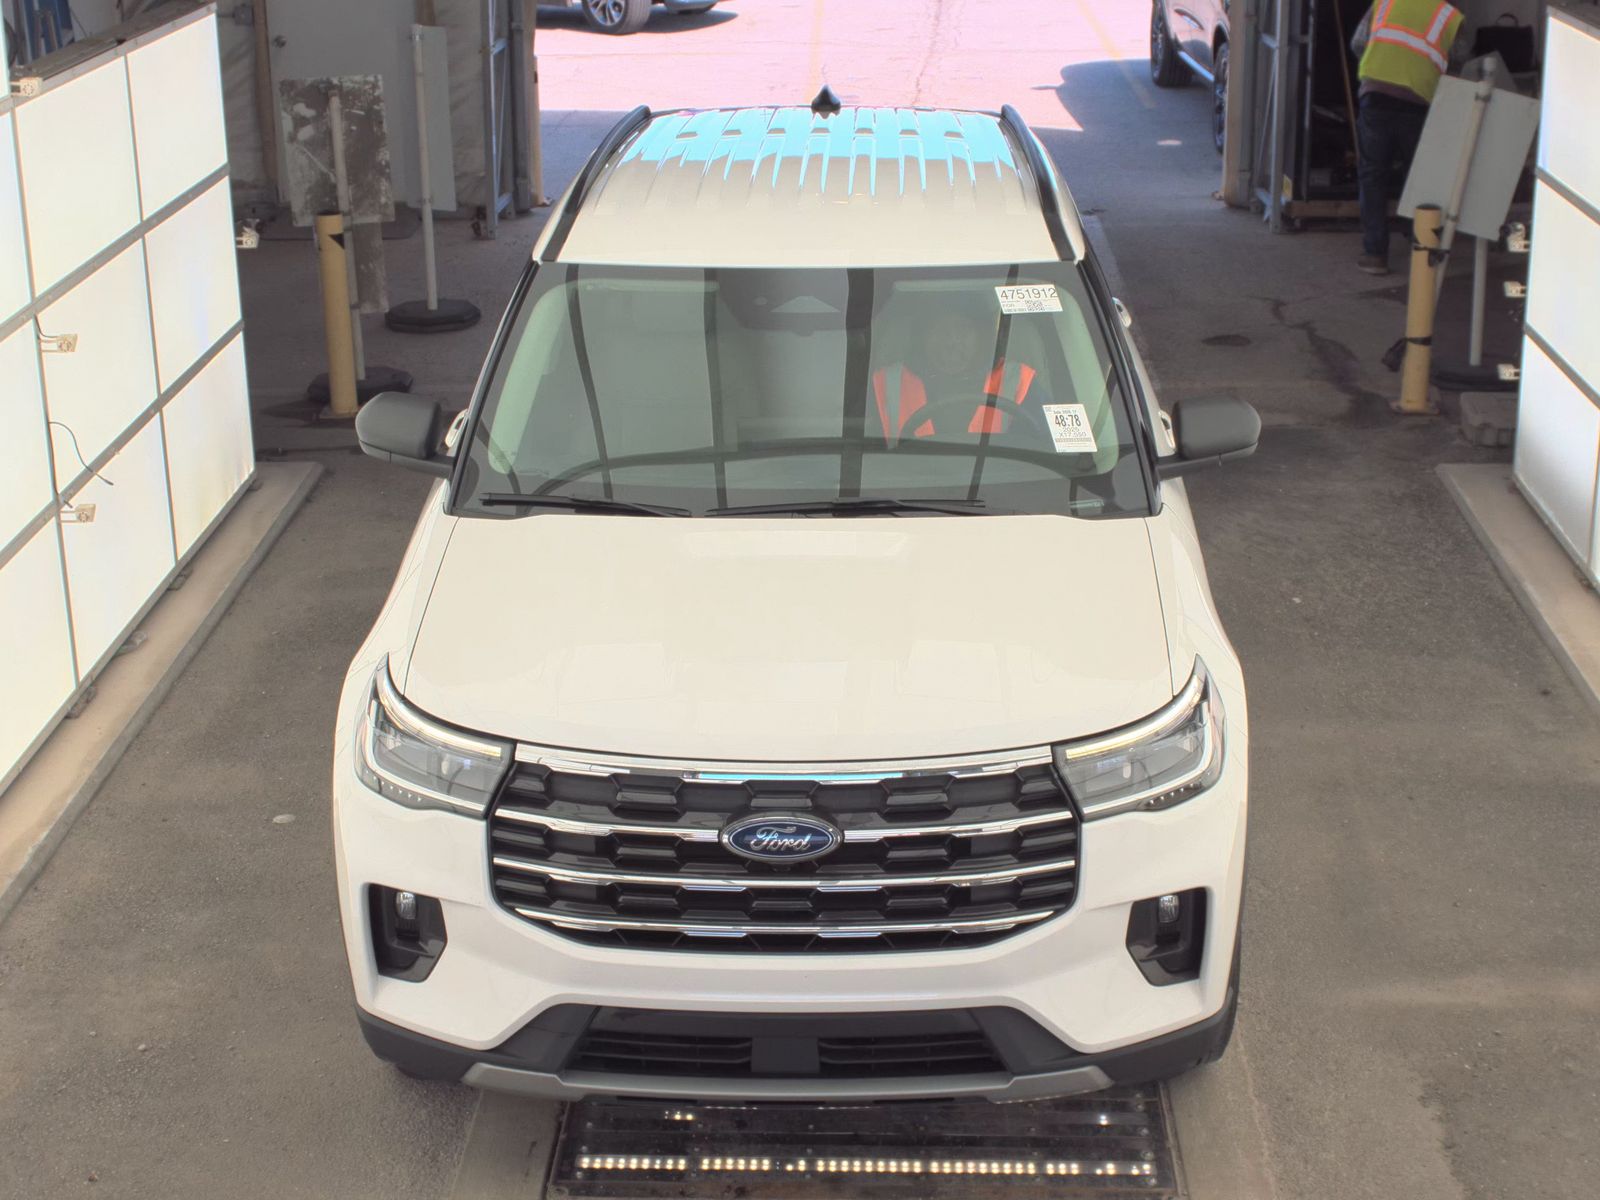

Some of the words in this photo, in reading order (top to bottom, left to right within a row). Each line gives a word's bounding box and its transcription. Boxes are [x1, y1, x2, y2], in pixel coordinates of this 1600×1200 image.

[1000, 287, 1058, 300] 4751912
[1054, 414, 1081, 427] 48:78
[750, 826, 812, 851] Ford
